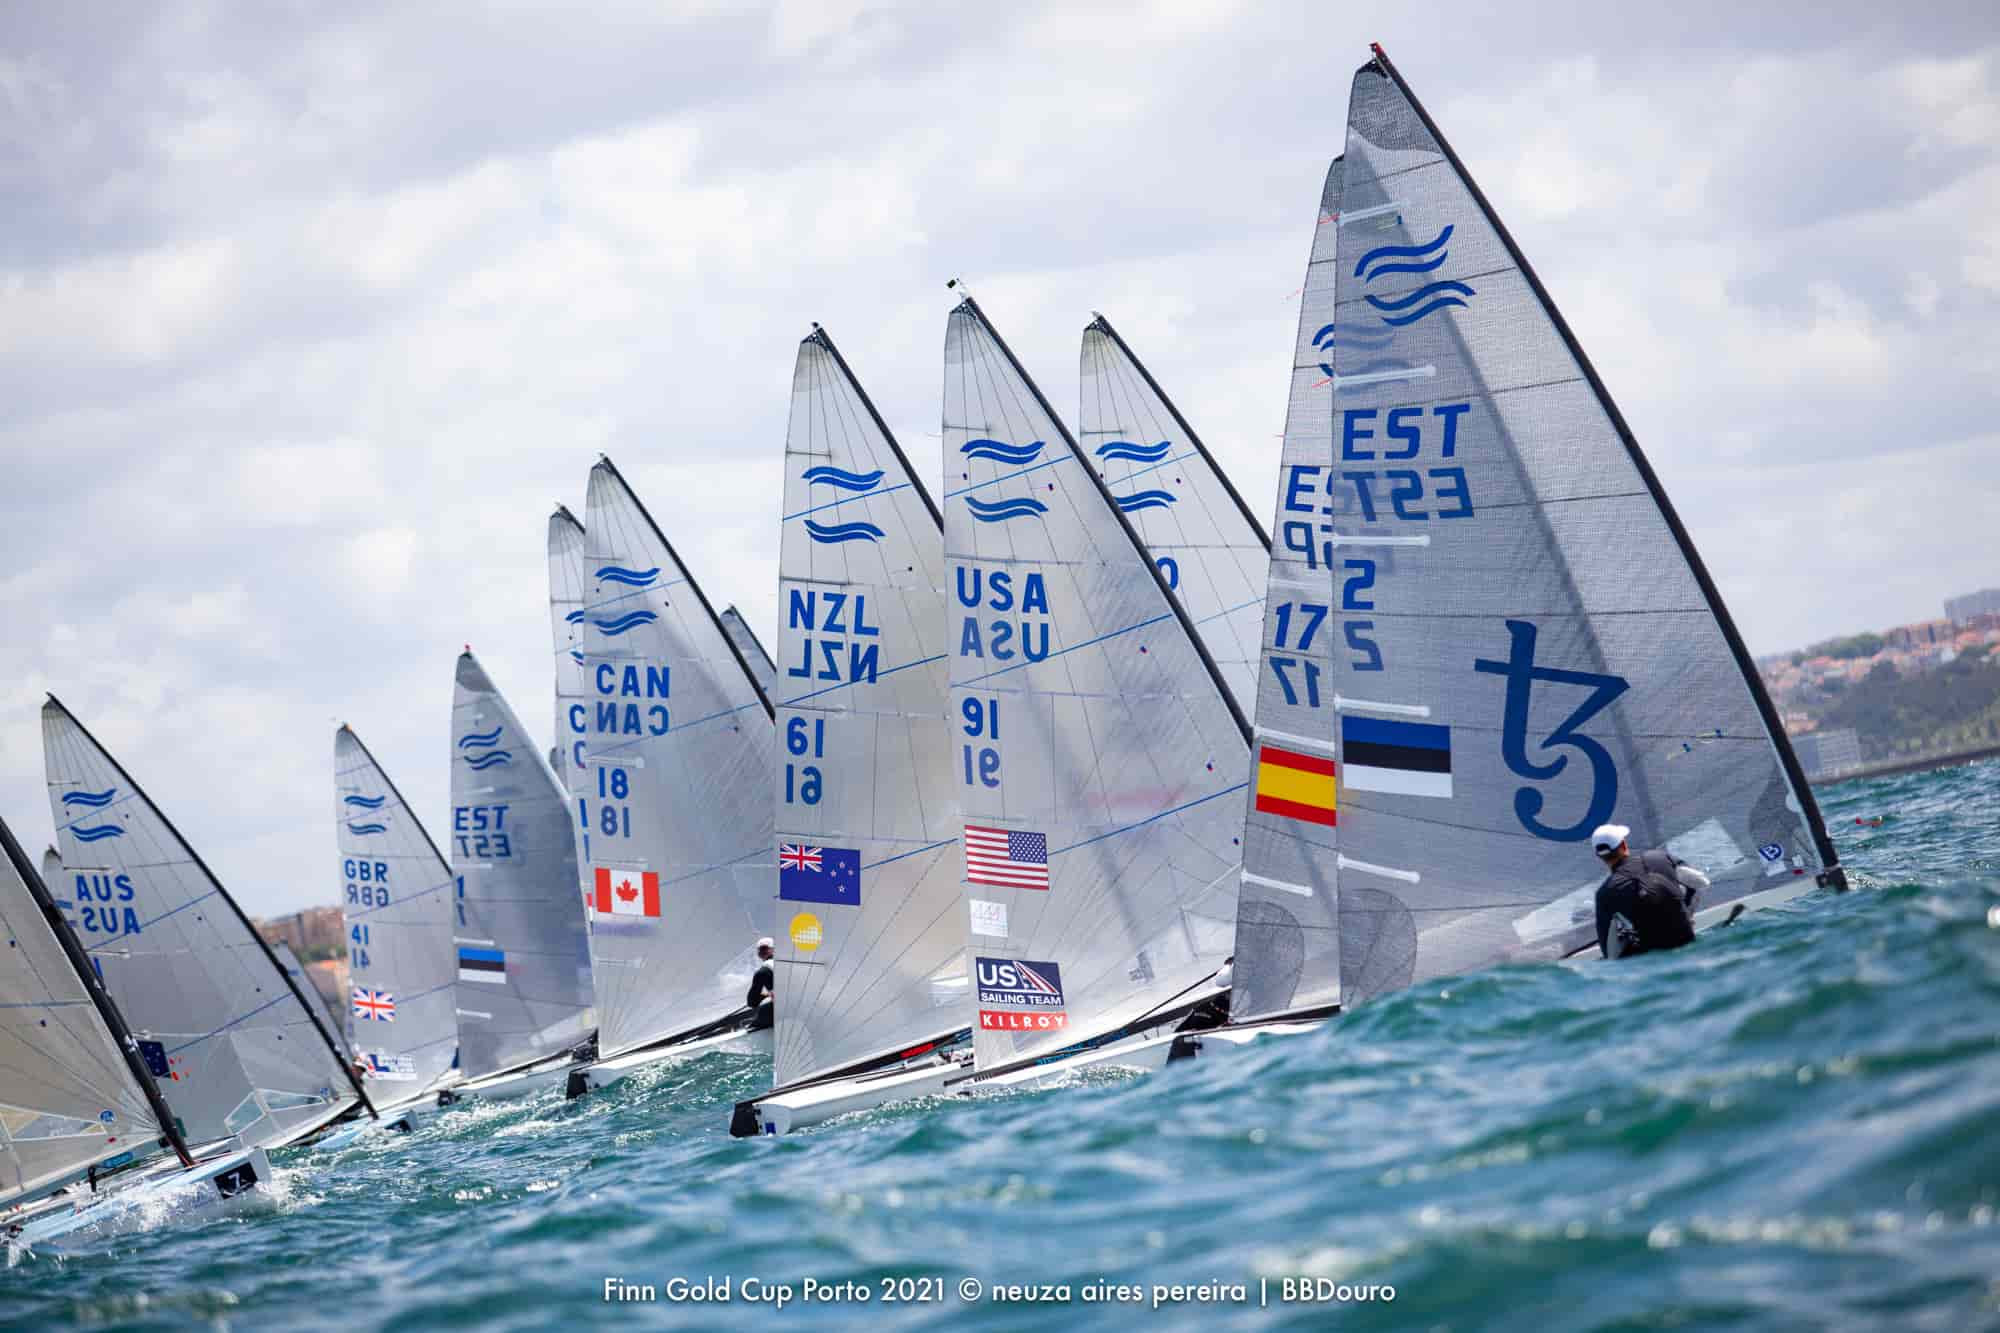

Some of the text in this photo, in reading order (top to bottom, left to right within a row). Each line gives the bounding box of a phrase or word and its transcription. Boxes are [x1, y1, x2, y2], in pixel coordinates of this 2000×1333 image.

[1342, 403, 1471, 461] EST
[957, 566, 1049, 614] USA
[1342, 559, 1376, 610] 2
[789, 589, 879, 637] NZL
[1275, 602, 1328, 650] 17
[596, 663, 670, 698] CAN
[962, 697, 999, 740] 91
[786, 716, 824, 758] 61
[598, 766, 629, 799] 18
[455, 805, 509, 831] EST
[75, 874, 134, 902] AUS
[344, 859, 388, 883] GBR
[351, 924, 369, 945] 41
[981, 992, 1062, 1006] SAILING TEAM
[983, 1014, 1065, 1027] KILROY
